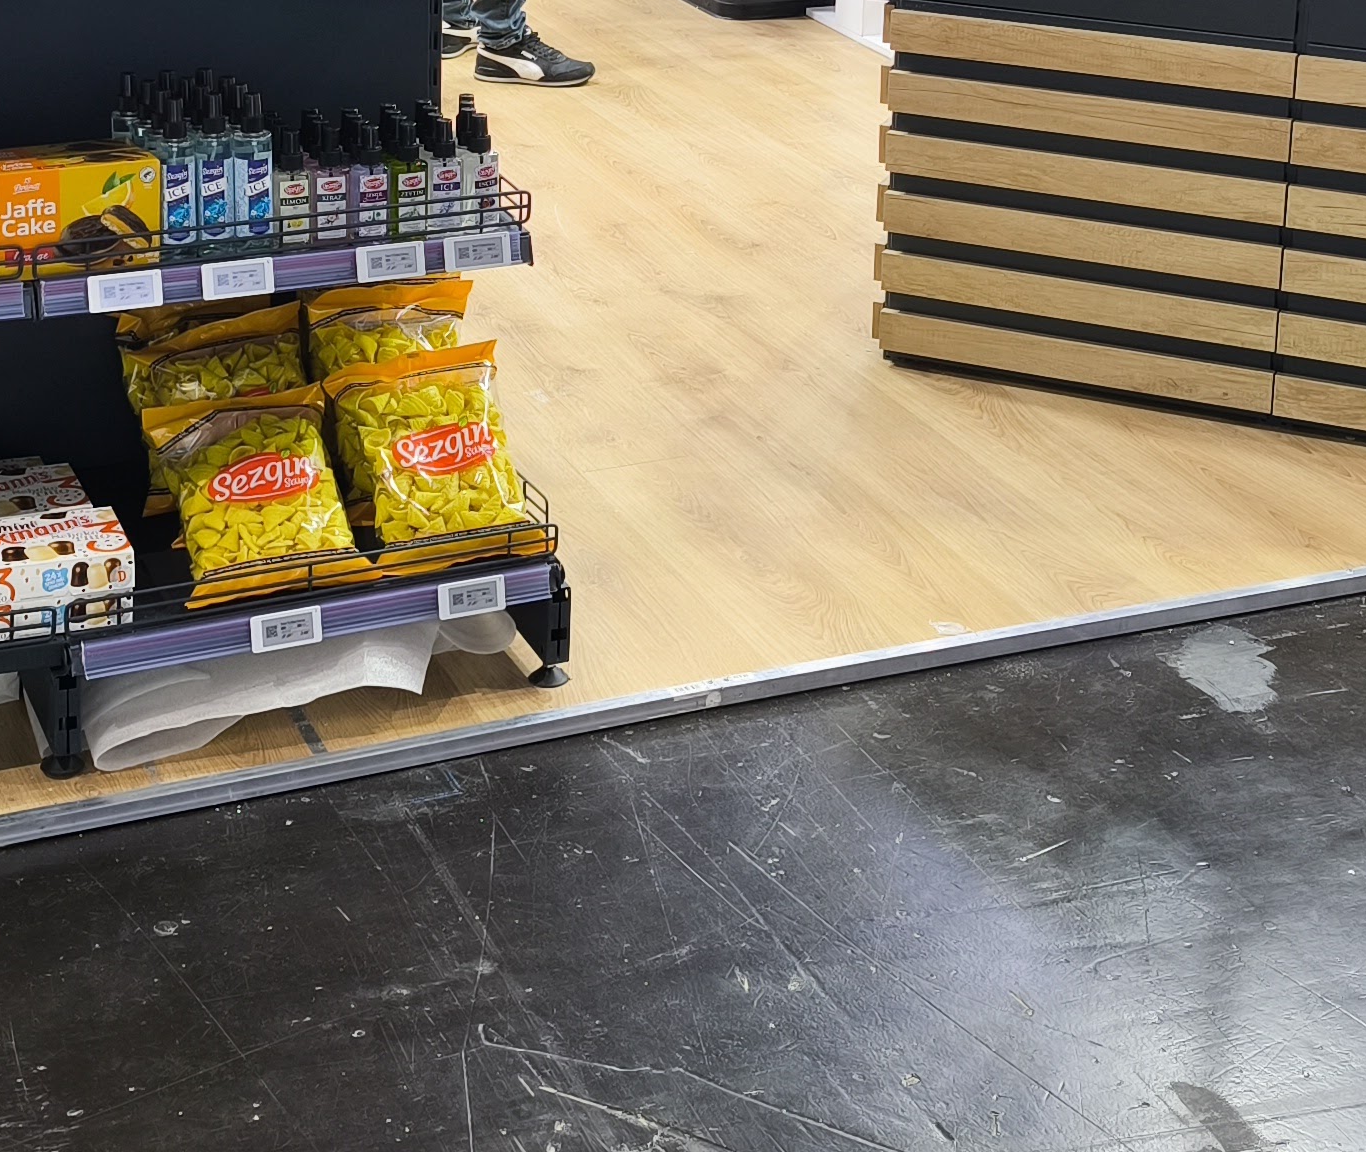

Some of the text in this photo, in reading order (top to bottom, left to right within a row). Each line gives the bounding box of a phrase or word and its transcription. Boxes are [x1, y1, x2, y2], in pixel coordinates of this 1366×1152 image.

[167, 185, 188, 199] ICE
[202, 181, 222, 194] ICE
[248, 180, 267, 193] ICE
[0, 197, 57, 220] Jaffa
[282, 197, 307, 206] LIMON
[1, 218, 57, 238] Cake
[395, 421, 492, 470] Sezgin
[211, 453, 314, 502] Sezgin
[117, 569, 127, 583] D
